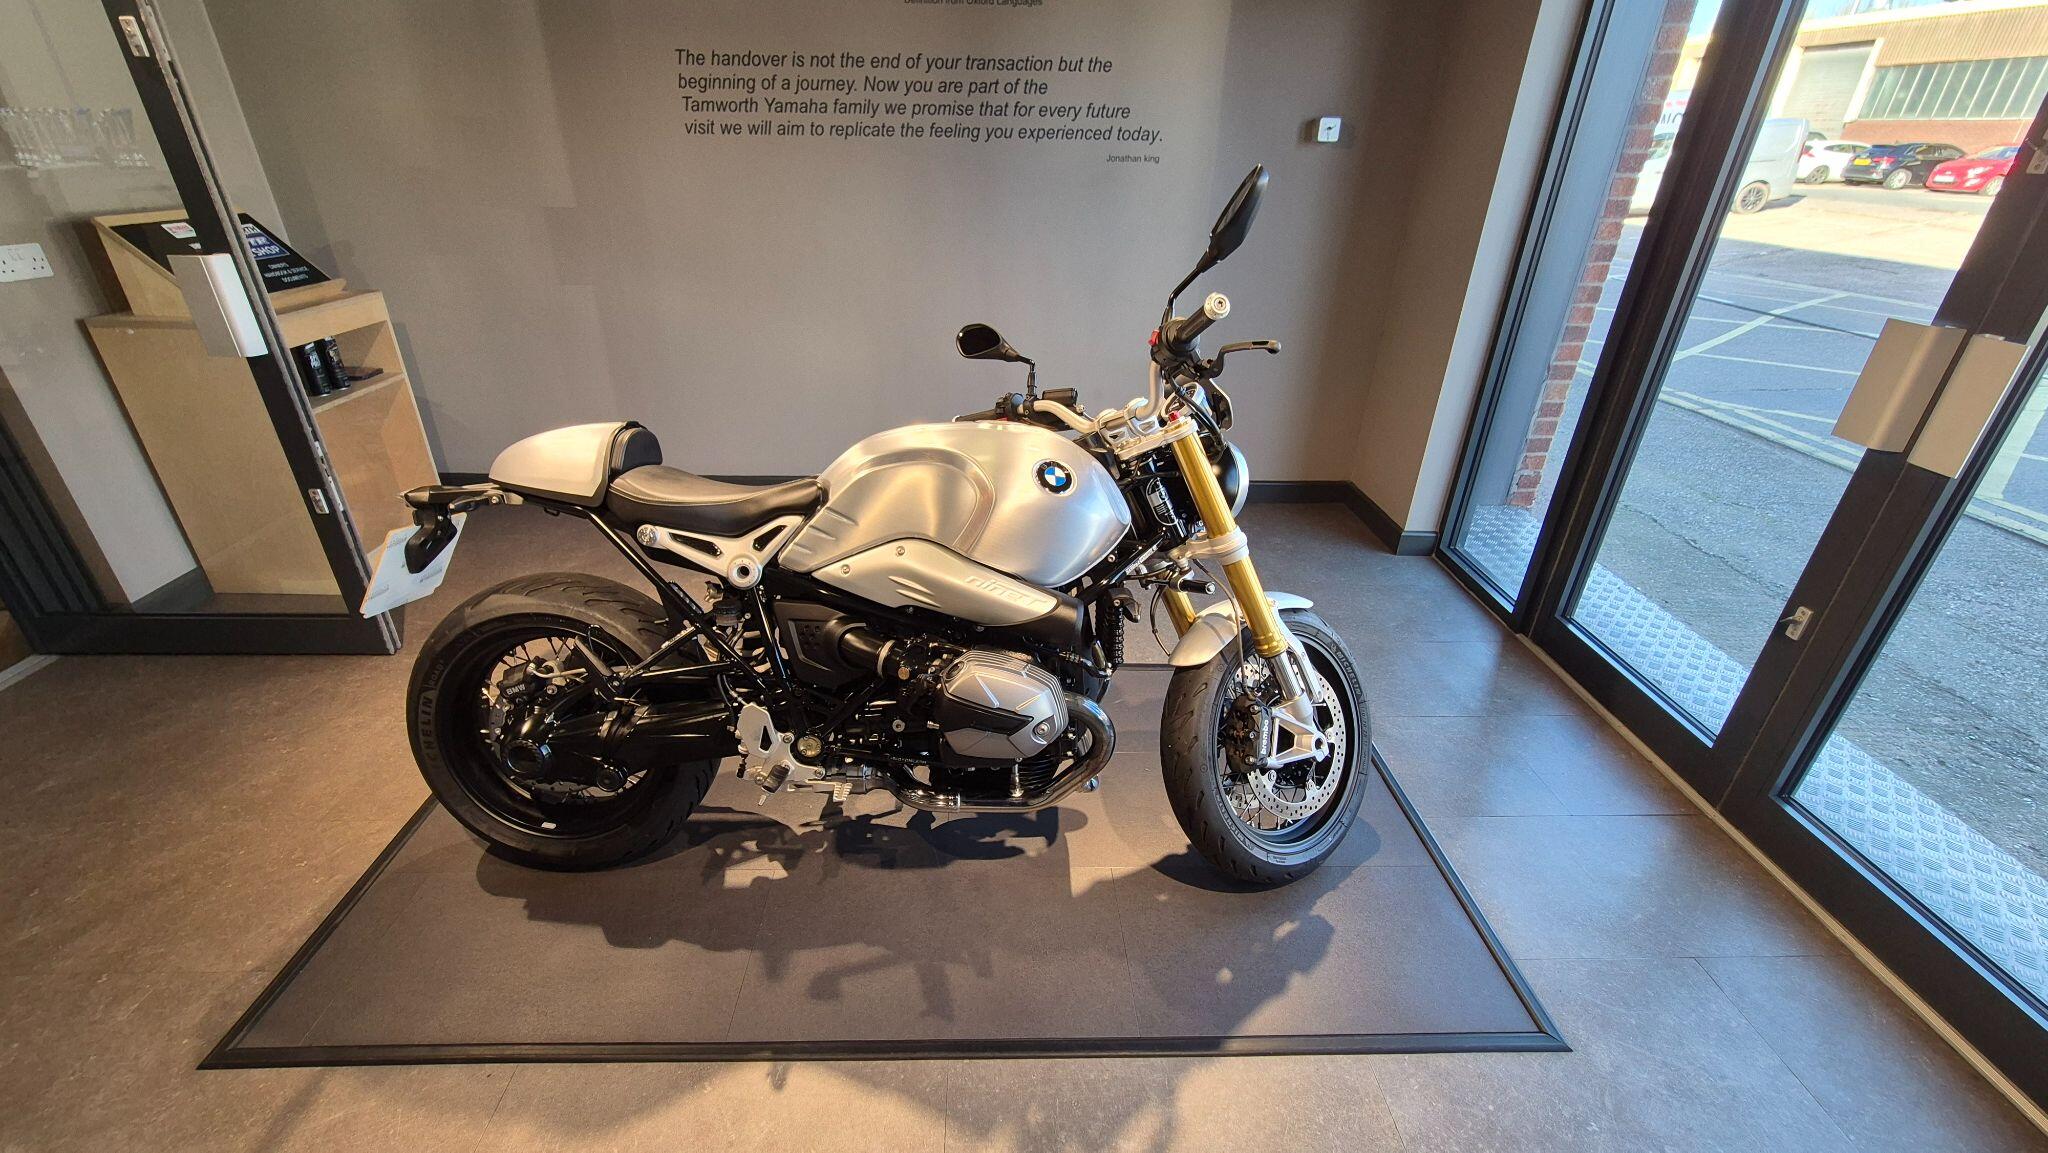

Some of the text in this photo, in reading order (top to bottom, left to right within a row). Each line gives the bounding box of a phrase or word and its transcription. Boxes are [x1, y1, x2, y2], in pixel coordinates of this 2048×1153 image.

[675, 49, 1112, 73] The handover is not the end of your transaction but the
[678, 73, 1048, 97] beginning of a journey. Now you are part of the
[682, 96, 1130, 122] Tamworth Yamaha family we promise that for every future
[685, 119, 1163, 145] visit we will aim to replicate the feeling you experienced today.
[1106, 154, 1160, 164] Jonathan king
[506, 684, 525, 695] BMW
[1261, 720, 1269, 754] brembo
